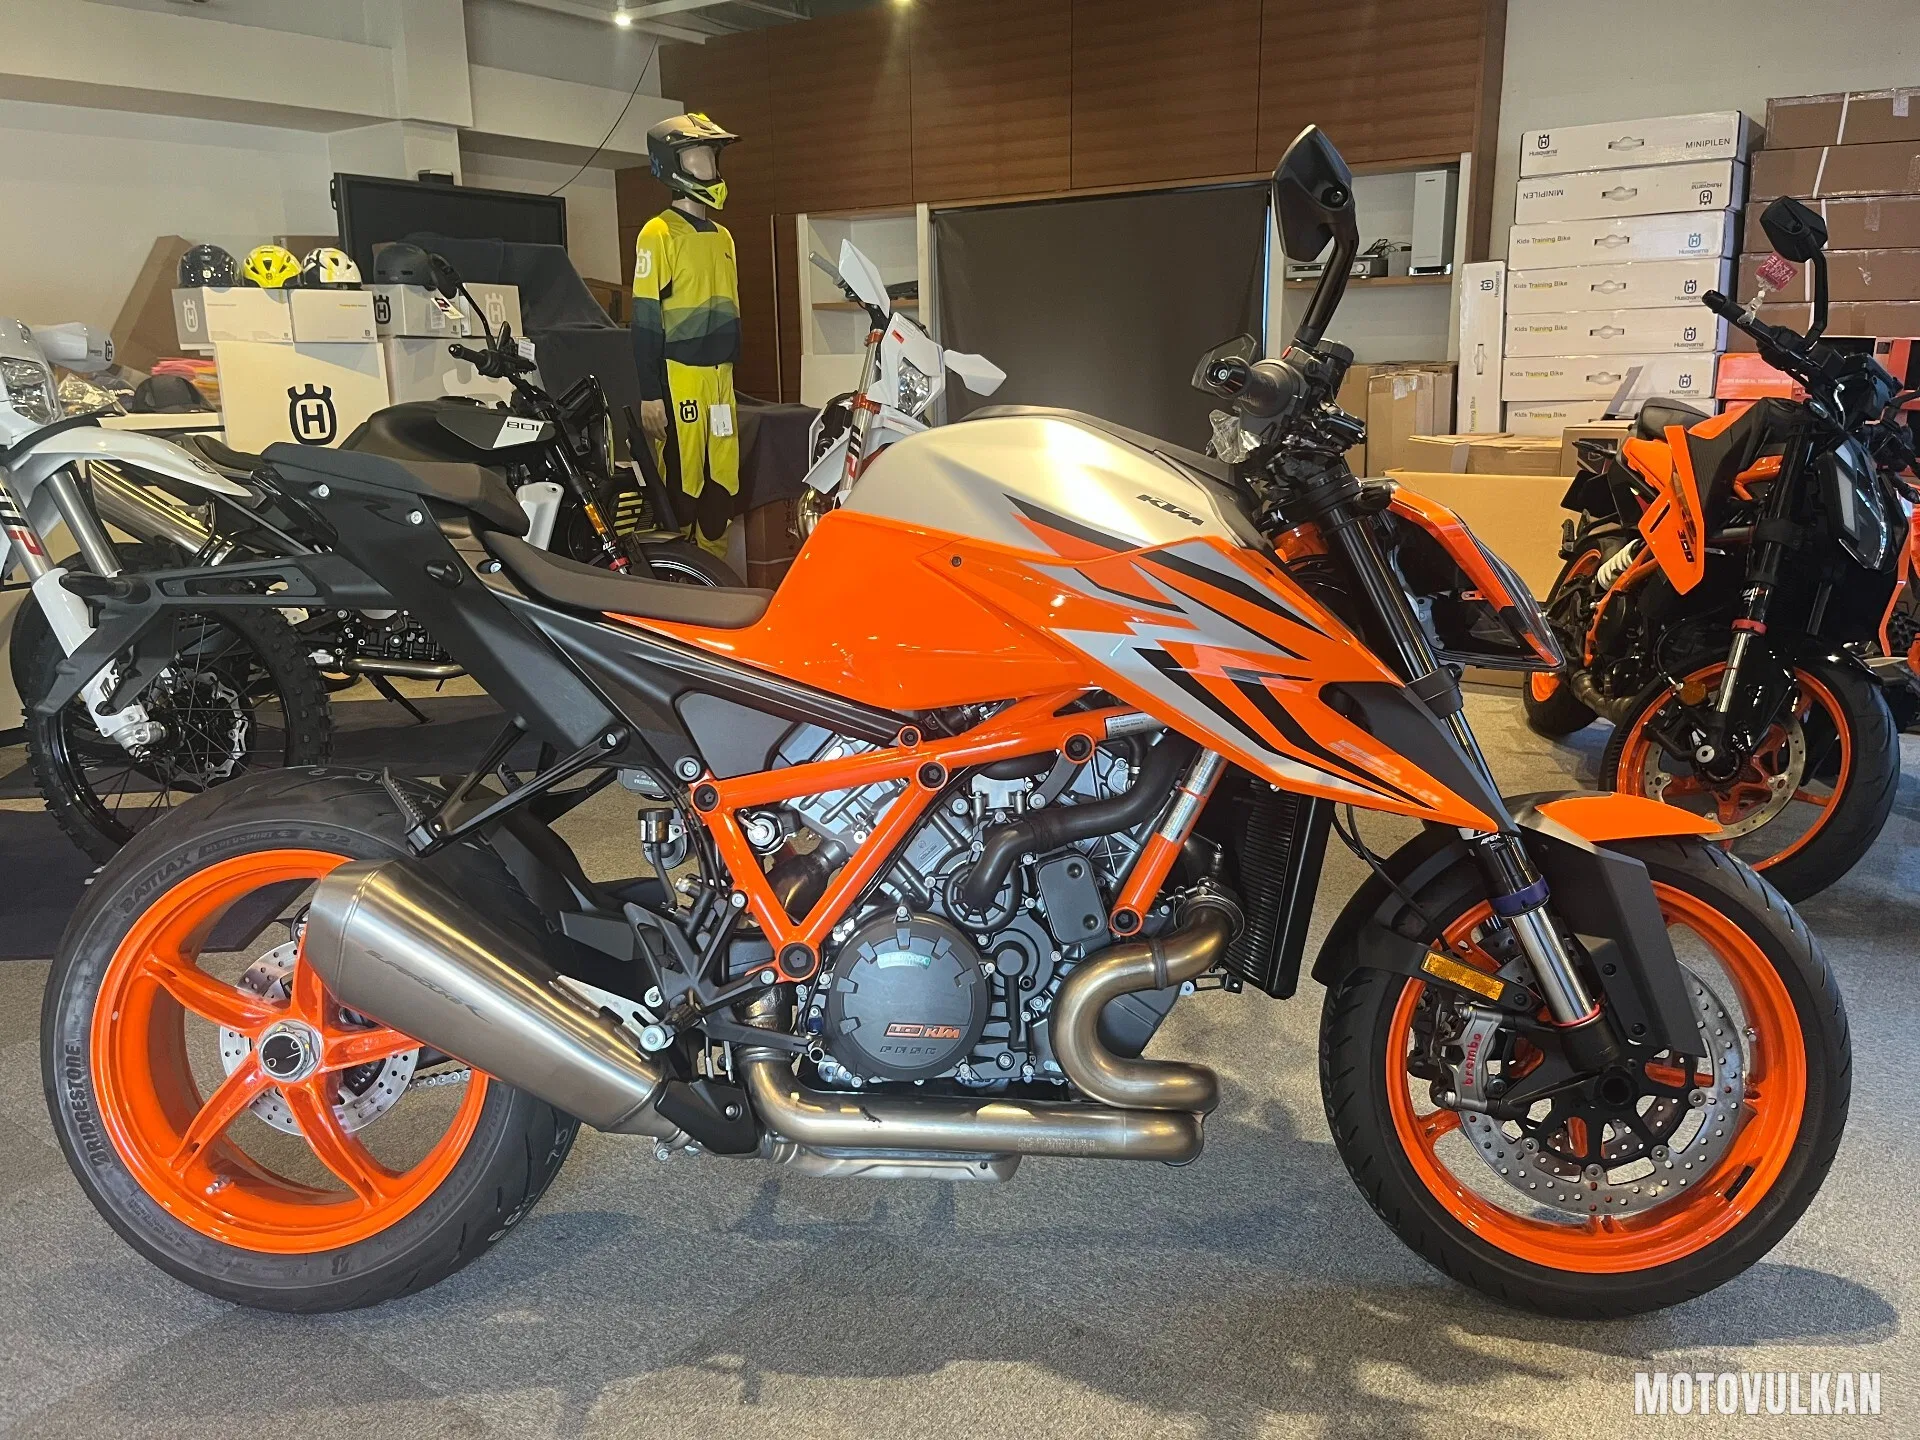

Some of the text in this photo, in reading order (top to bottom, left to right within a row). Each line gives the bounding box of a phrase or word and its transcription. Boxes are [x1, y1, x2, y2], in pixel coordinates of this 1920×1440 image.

[1685, 138, 1731, 149] MINIPILEN
[1691, 182, 1722, 190] Husqvarna
[1523, 189, 1564, 199] MINIPILEN
[1532, 236, 1556, 245] Training
[1529, 281, 1553, 290] Training
[1529, 325, 1553, 333] Training
[1525, 370, 1548, 378] Training
[1529, 411, 1552, 419] Training
[507, 421, 539, 431] 801
[1136, 494, 1204, 526] KTM
[309, 830, 350, 844] S22
[924, 1026, 961, 1038] KTM
[1464, 1033, 1482, 1087] brembo
[65, 1044, 112, 1167] BRIDGESTONE
